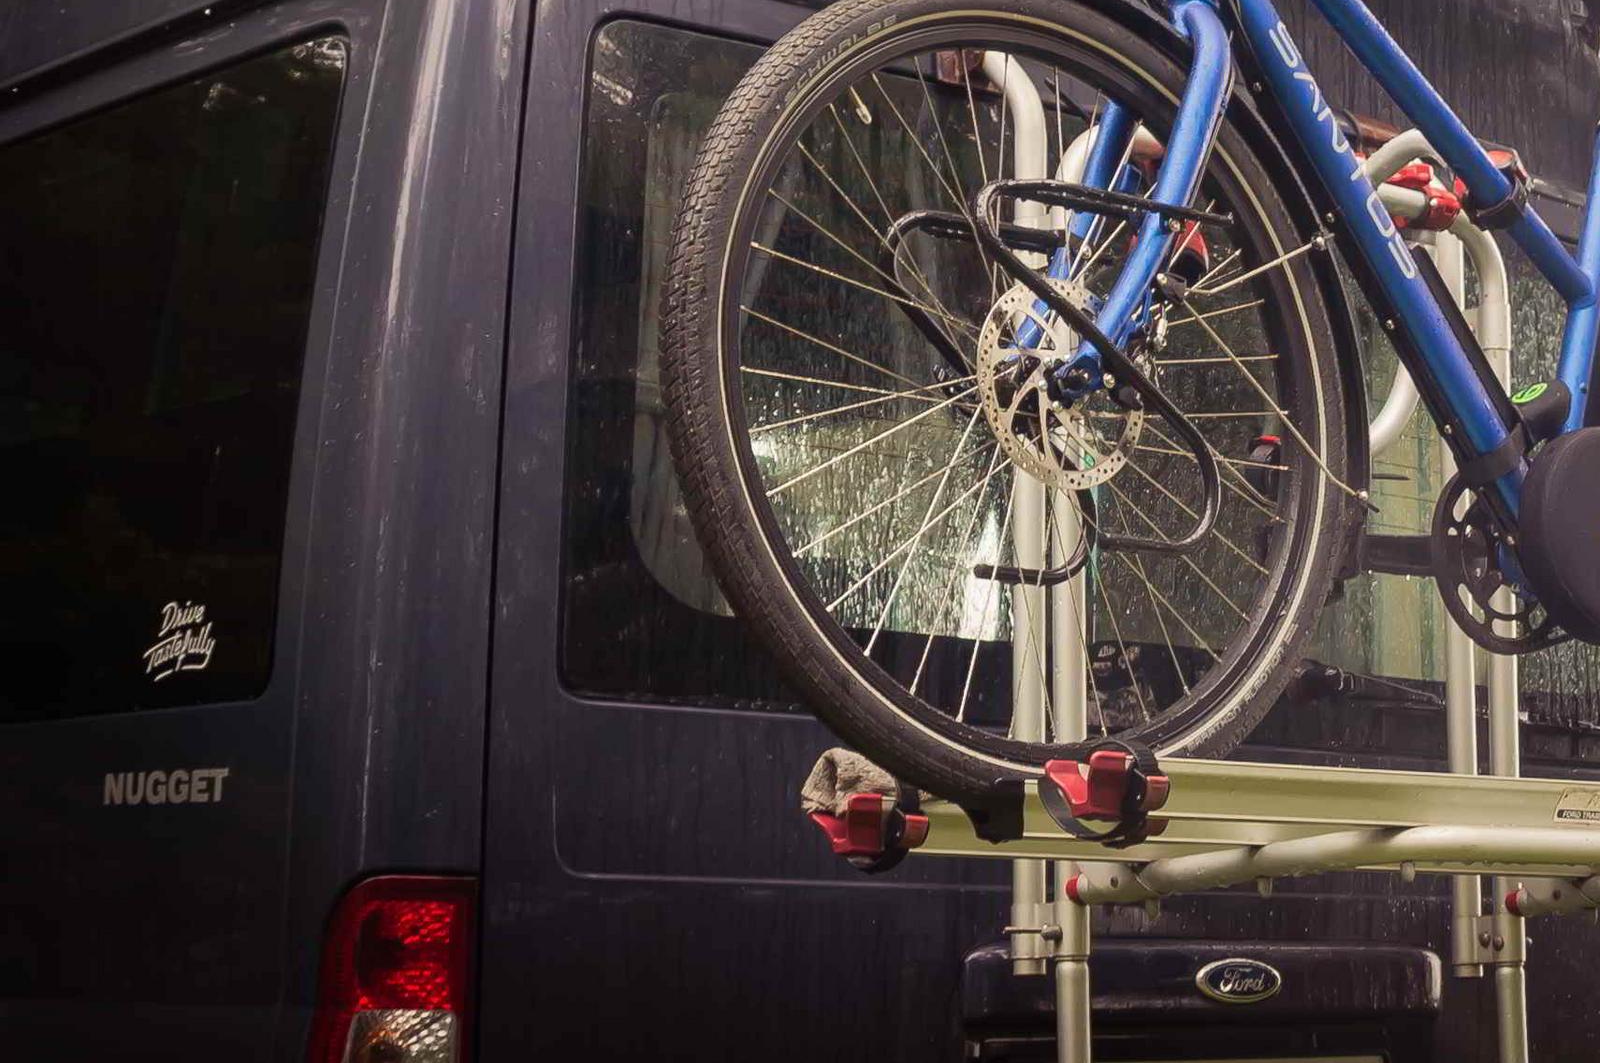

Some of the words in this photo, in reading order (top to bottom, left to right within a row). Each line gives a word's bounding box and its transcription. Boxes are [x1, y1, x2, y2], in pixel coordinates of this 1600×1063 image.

[784, 14, 898, 104] SCHWALBE
[158, 600, 206, 637] Drive
[142, 621, 217, 682] Tastefully
[103, 767, 230, 806] NUGGET
[1219, 966, 1266, 994] Ford
